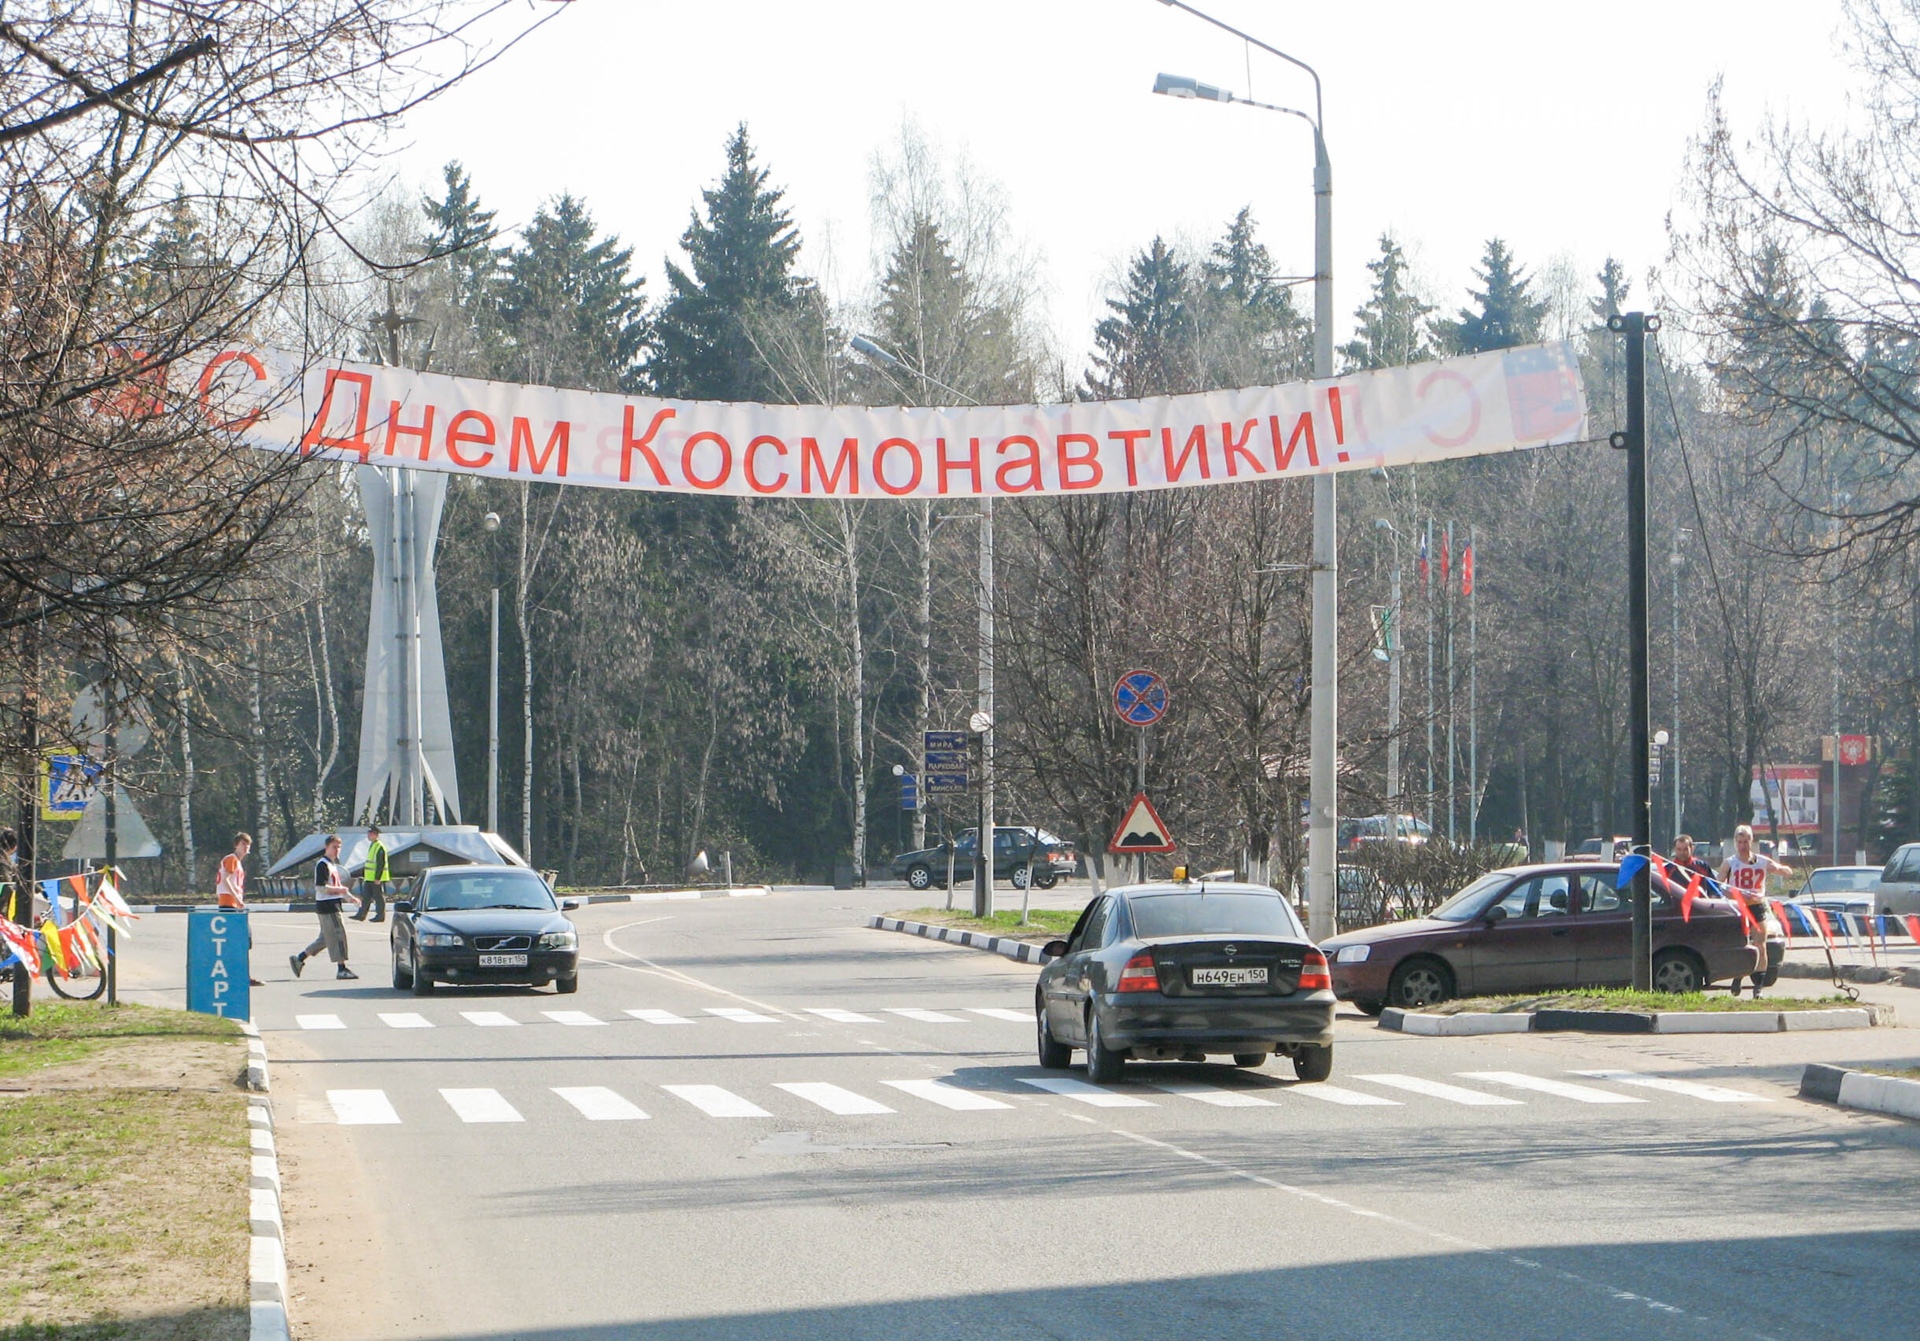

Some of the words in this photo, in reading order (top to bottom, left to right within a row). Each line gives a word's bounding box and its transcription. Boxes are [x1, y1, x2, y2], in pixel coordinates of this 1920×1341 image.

[198, 350, 268, 432] С
[300, 368, 571, 478] Днем
[619, 386, 1351, 496] Космонавтики!
[210, 915, 230, 1017] СТАРТ
[1197, 970, 1245, 983] Н649ЕН
[1248, 970, 1265, 979] 150
